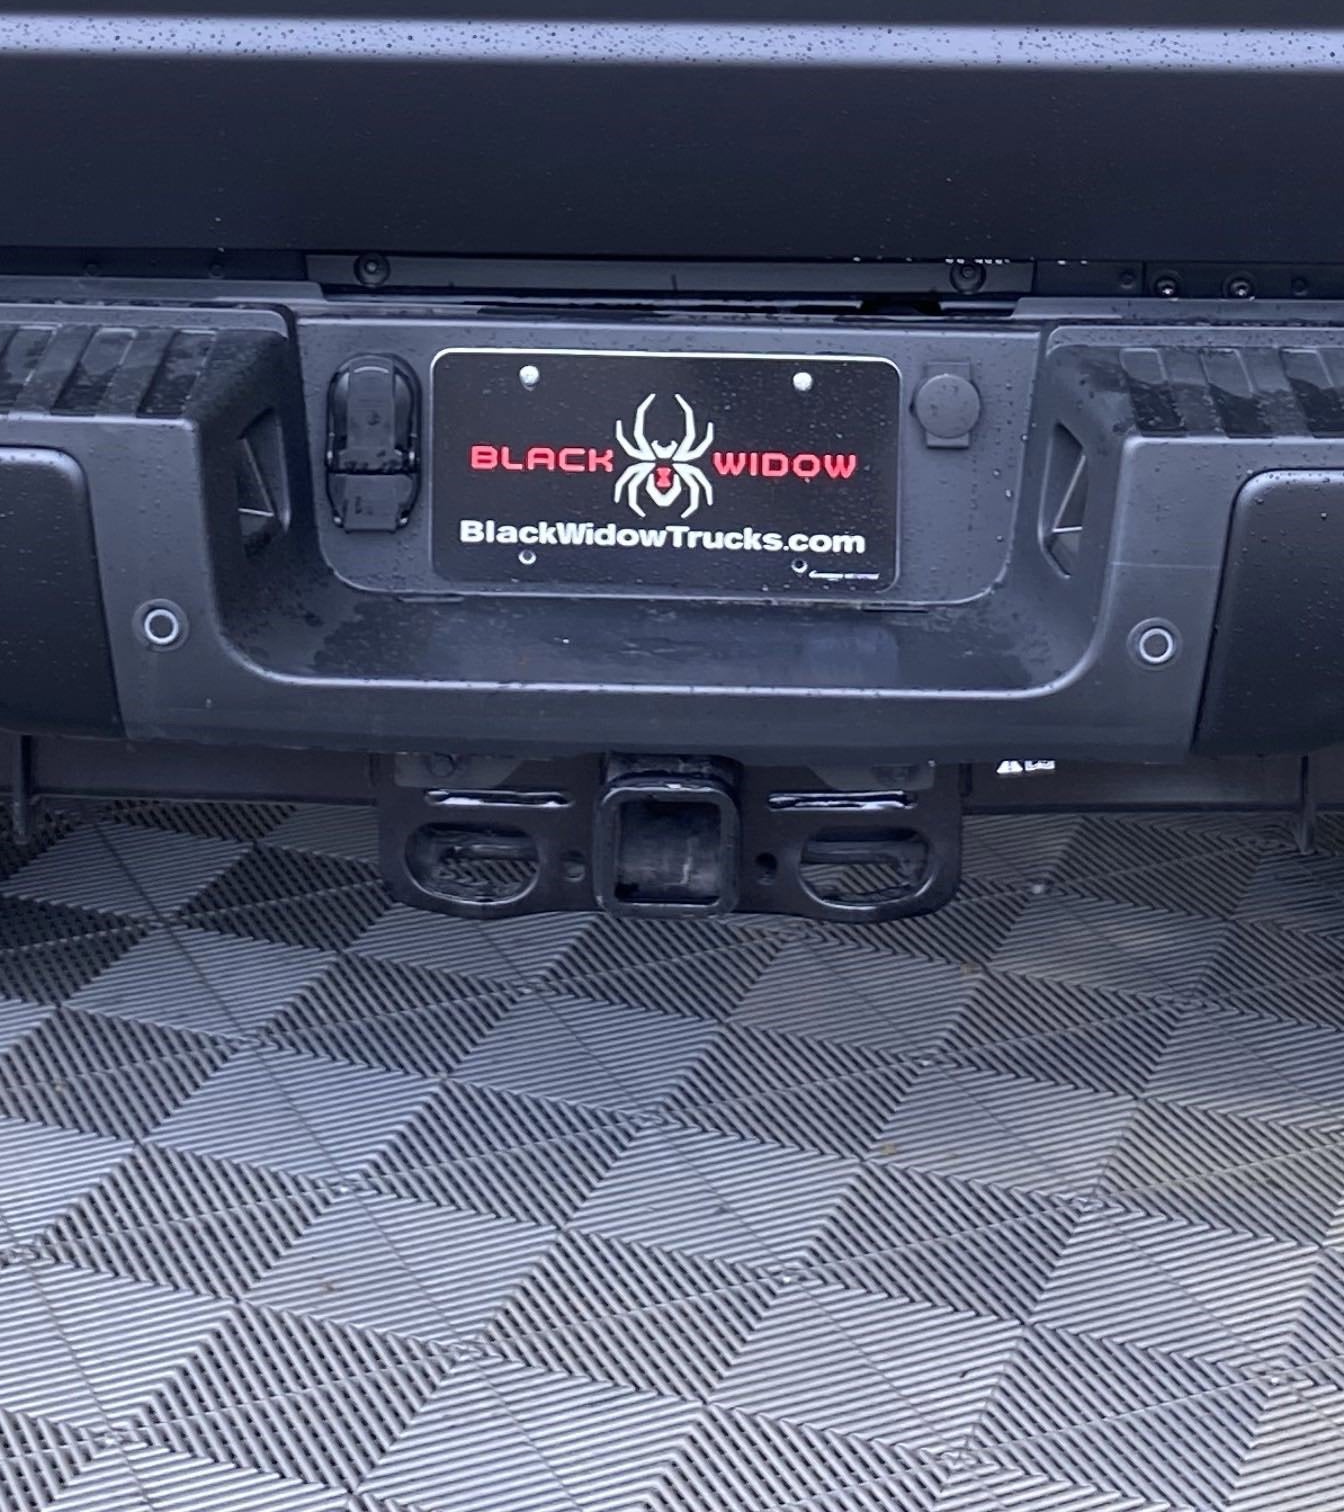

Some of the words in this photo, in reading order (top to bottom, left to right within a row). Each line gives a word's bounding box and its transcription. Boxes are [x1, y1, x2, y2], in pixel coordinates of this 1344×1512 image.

[469, 445, 613, 473] BLACK
[712, 451, 857, 479] WIDOW
[459, 519, 865, 554] BlackWidowTrucks.com
